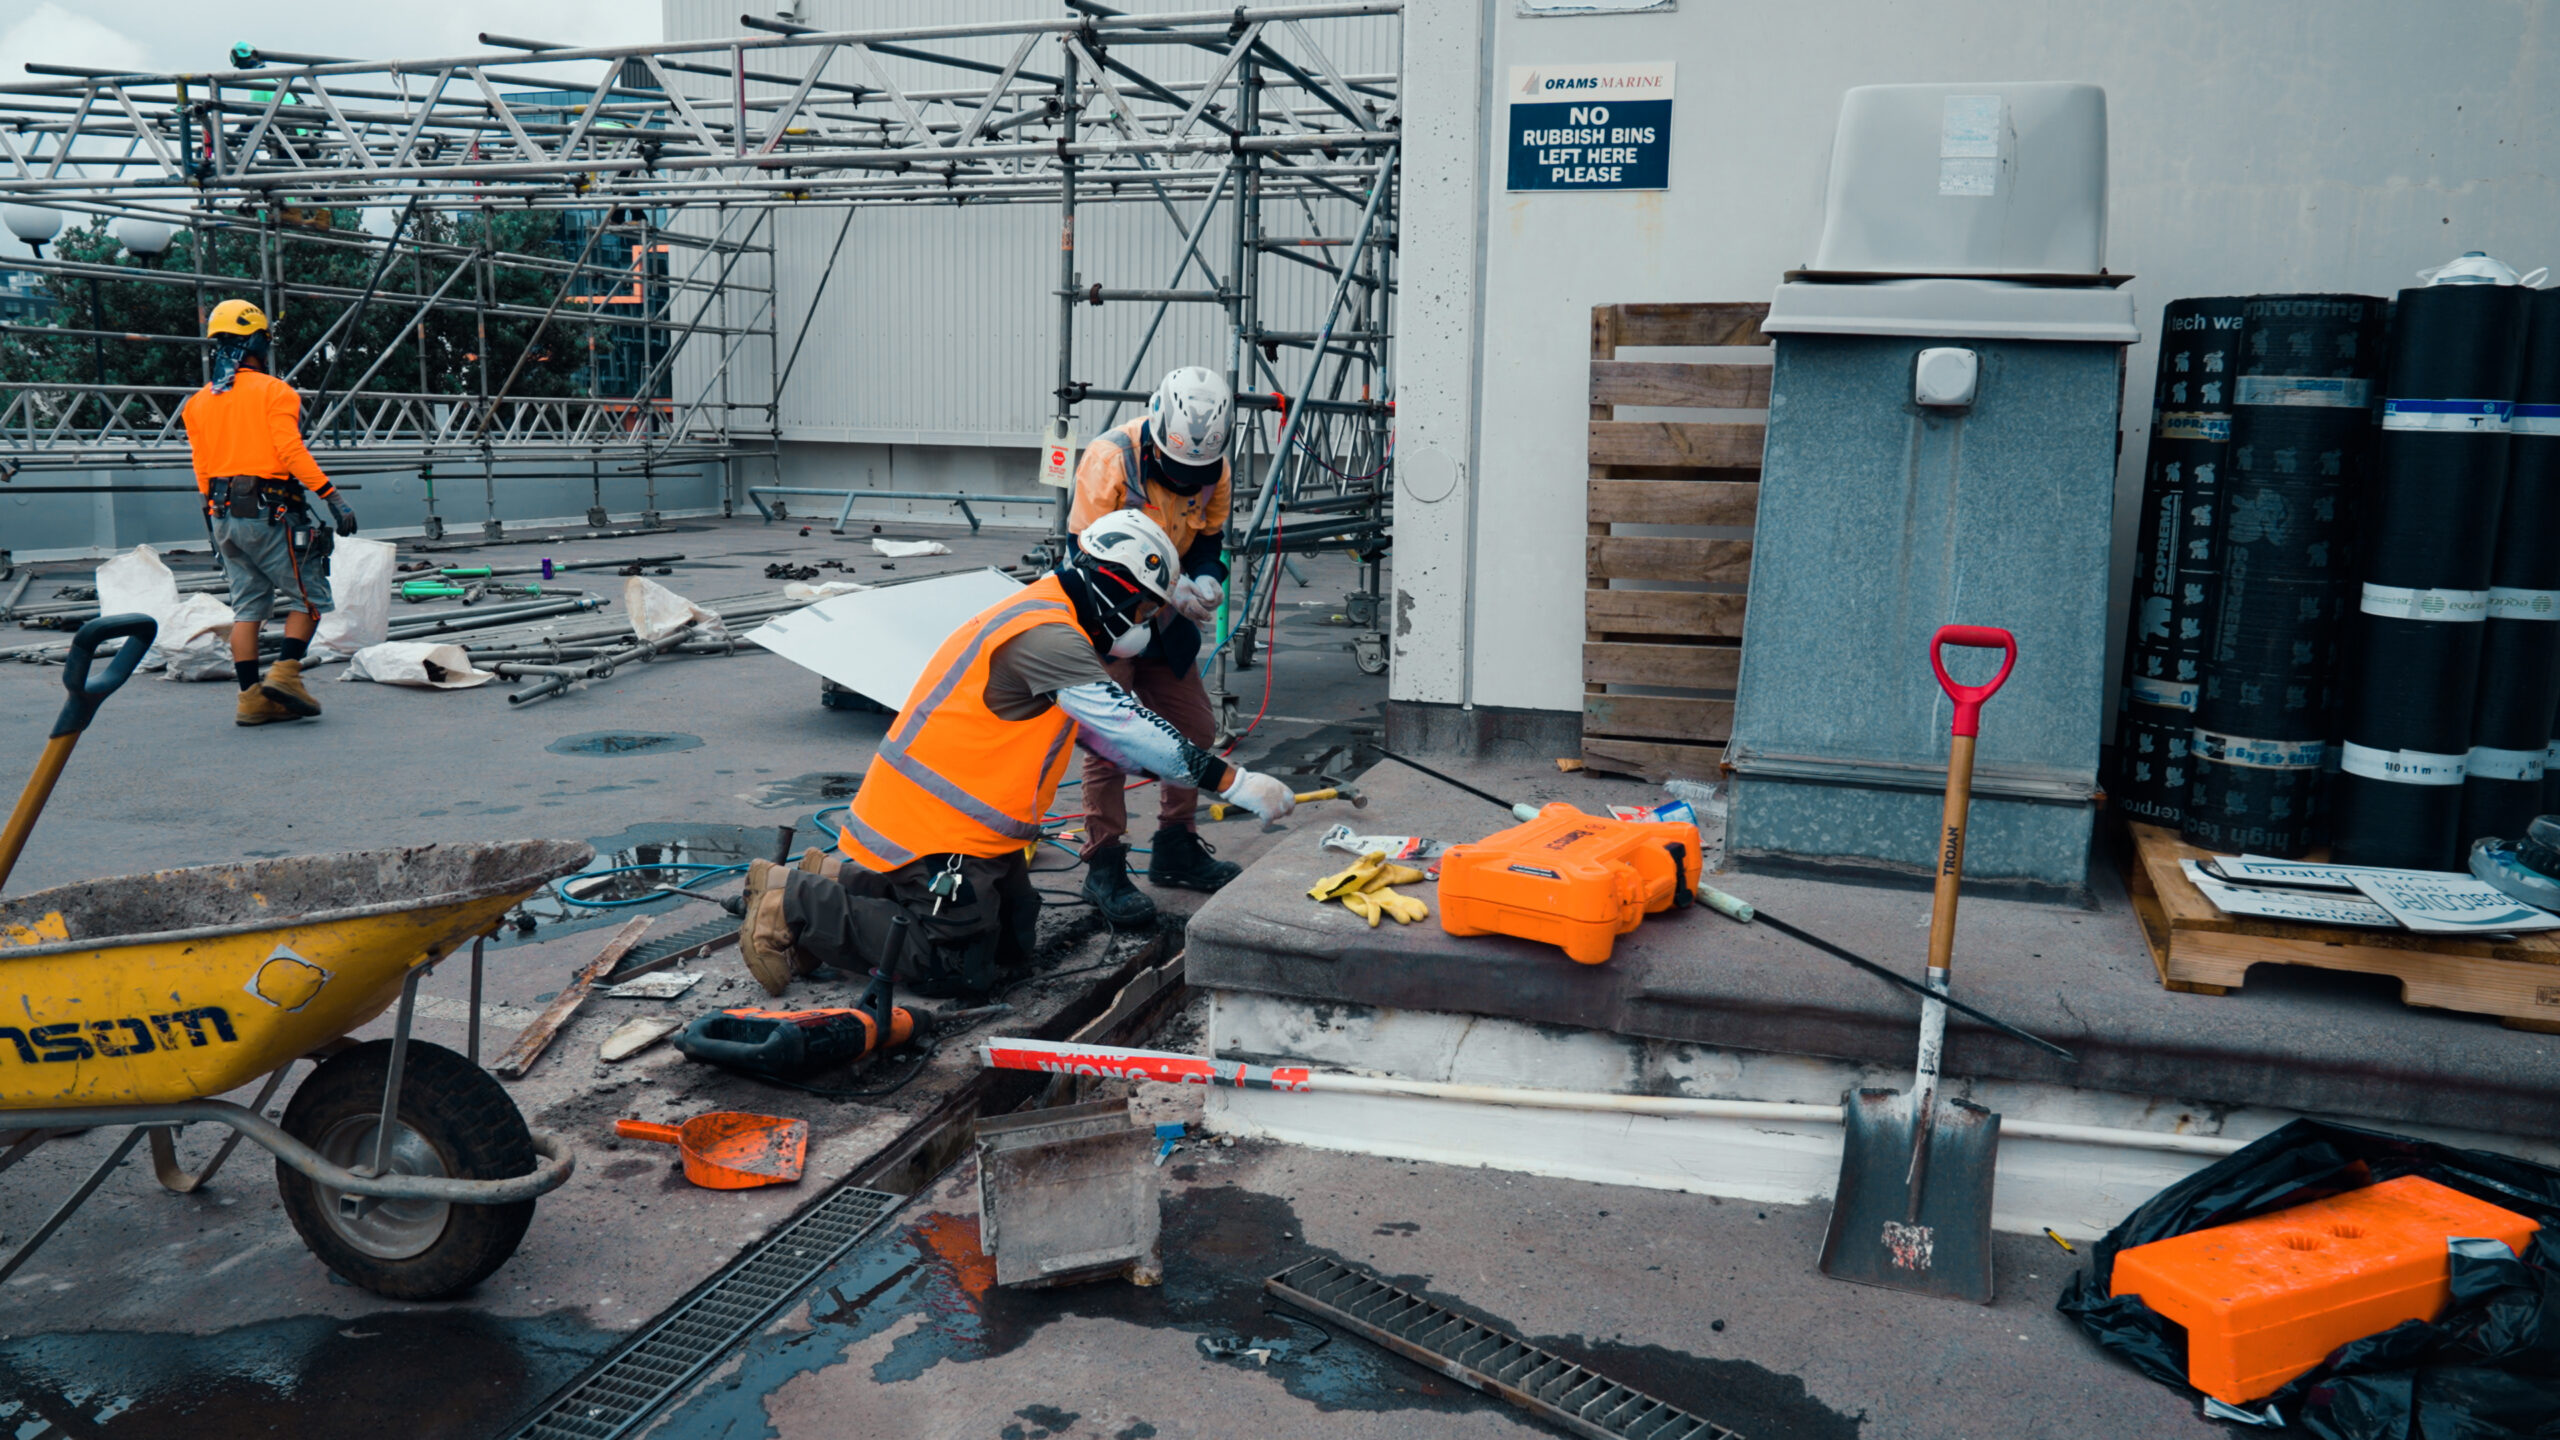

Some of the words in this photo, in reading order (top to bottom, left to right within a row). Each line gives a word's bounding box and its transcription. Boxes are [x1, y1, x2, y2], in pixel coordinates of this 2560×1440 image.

[1545, 77, 1598, 90] ORAMS
[1601, 75, 1663, 88] MARINE
[1569, 107, 1609, 125] NO
[1523, 129, 1604, 146] RUBBISH
[1611, 127, 1655, 144] BINS
[1539, 149, 1581, 164] LEFT
[1587, 148, 1637, 164] HERE
[1552, 167, 1622, 182] PLEASE
[2152, 494, 2173, 595] SOPREMA
[2231, 826, 2289, 852] high
[1942, 827, 1960, 877] TROJAN
